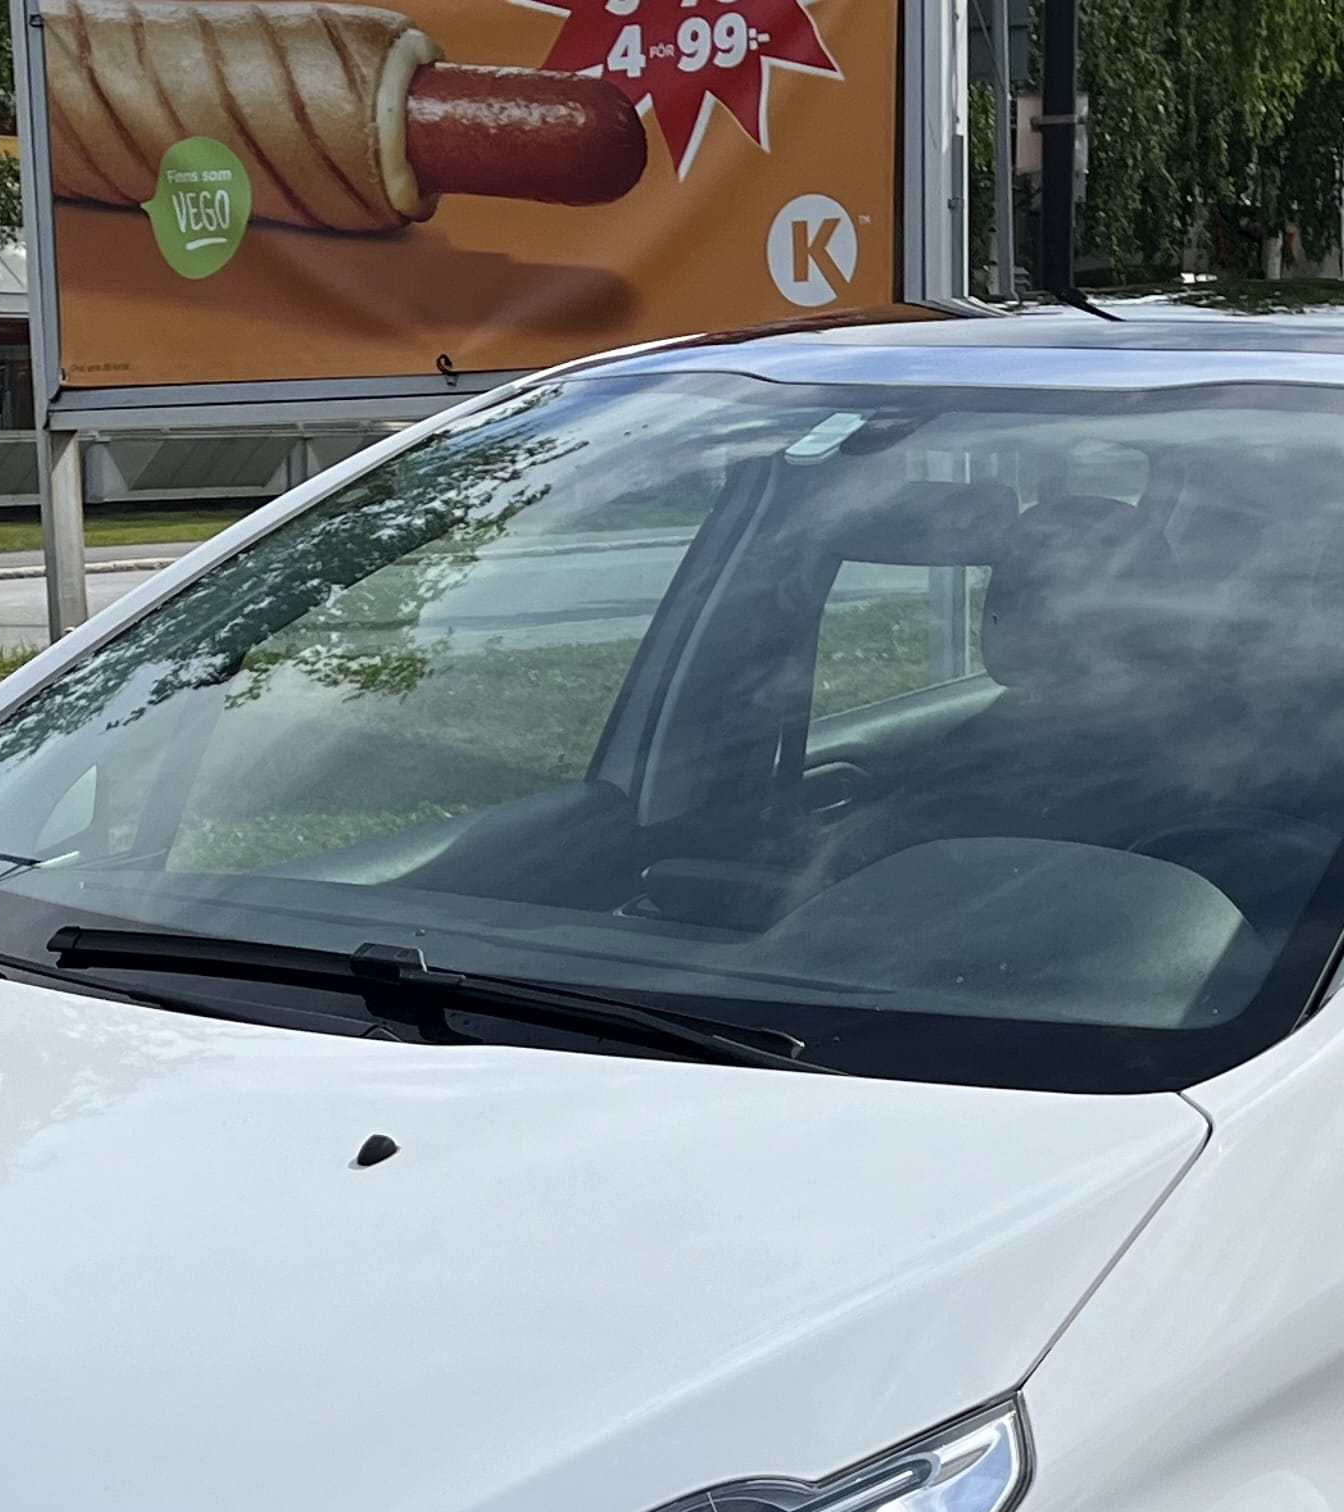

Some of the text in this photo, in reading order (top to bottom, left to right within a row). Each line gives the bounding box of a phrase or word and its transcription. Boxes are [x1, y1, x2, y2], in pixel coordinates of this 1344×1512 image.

[608, 24, 646, 77] 4
[677, 12, 770, 72] 99:-
[202, 170, 232, 181] som
[171, 189, 231, 232] VEGO
